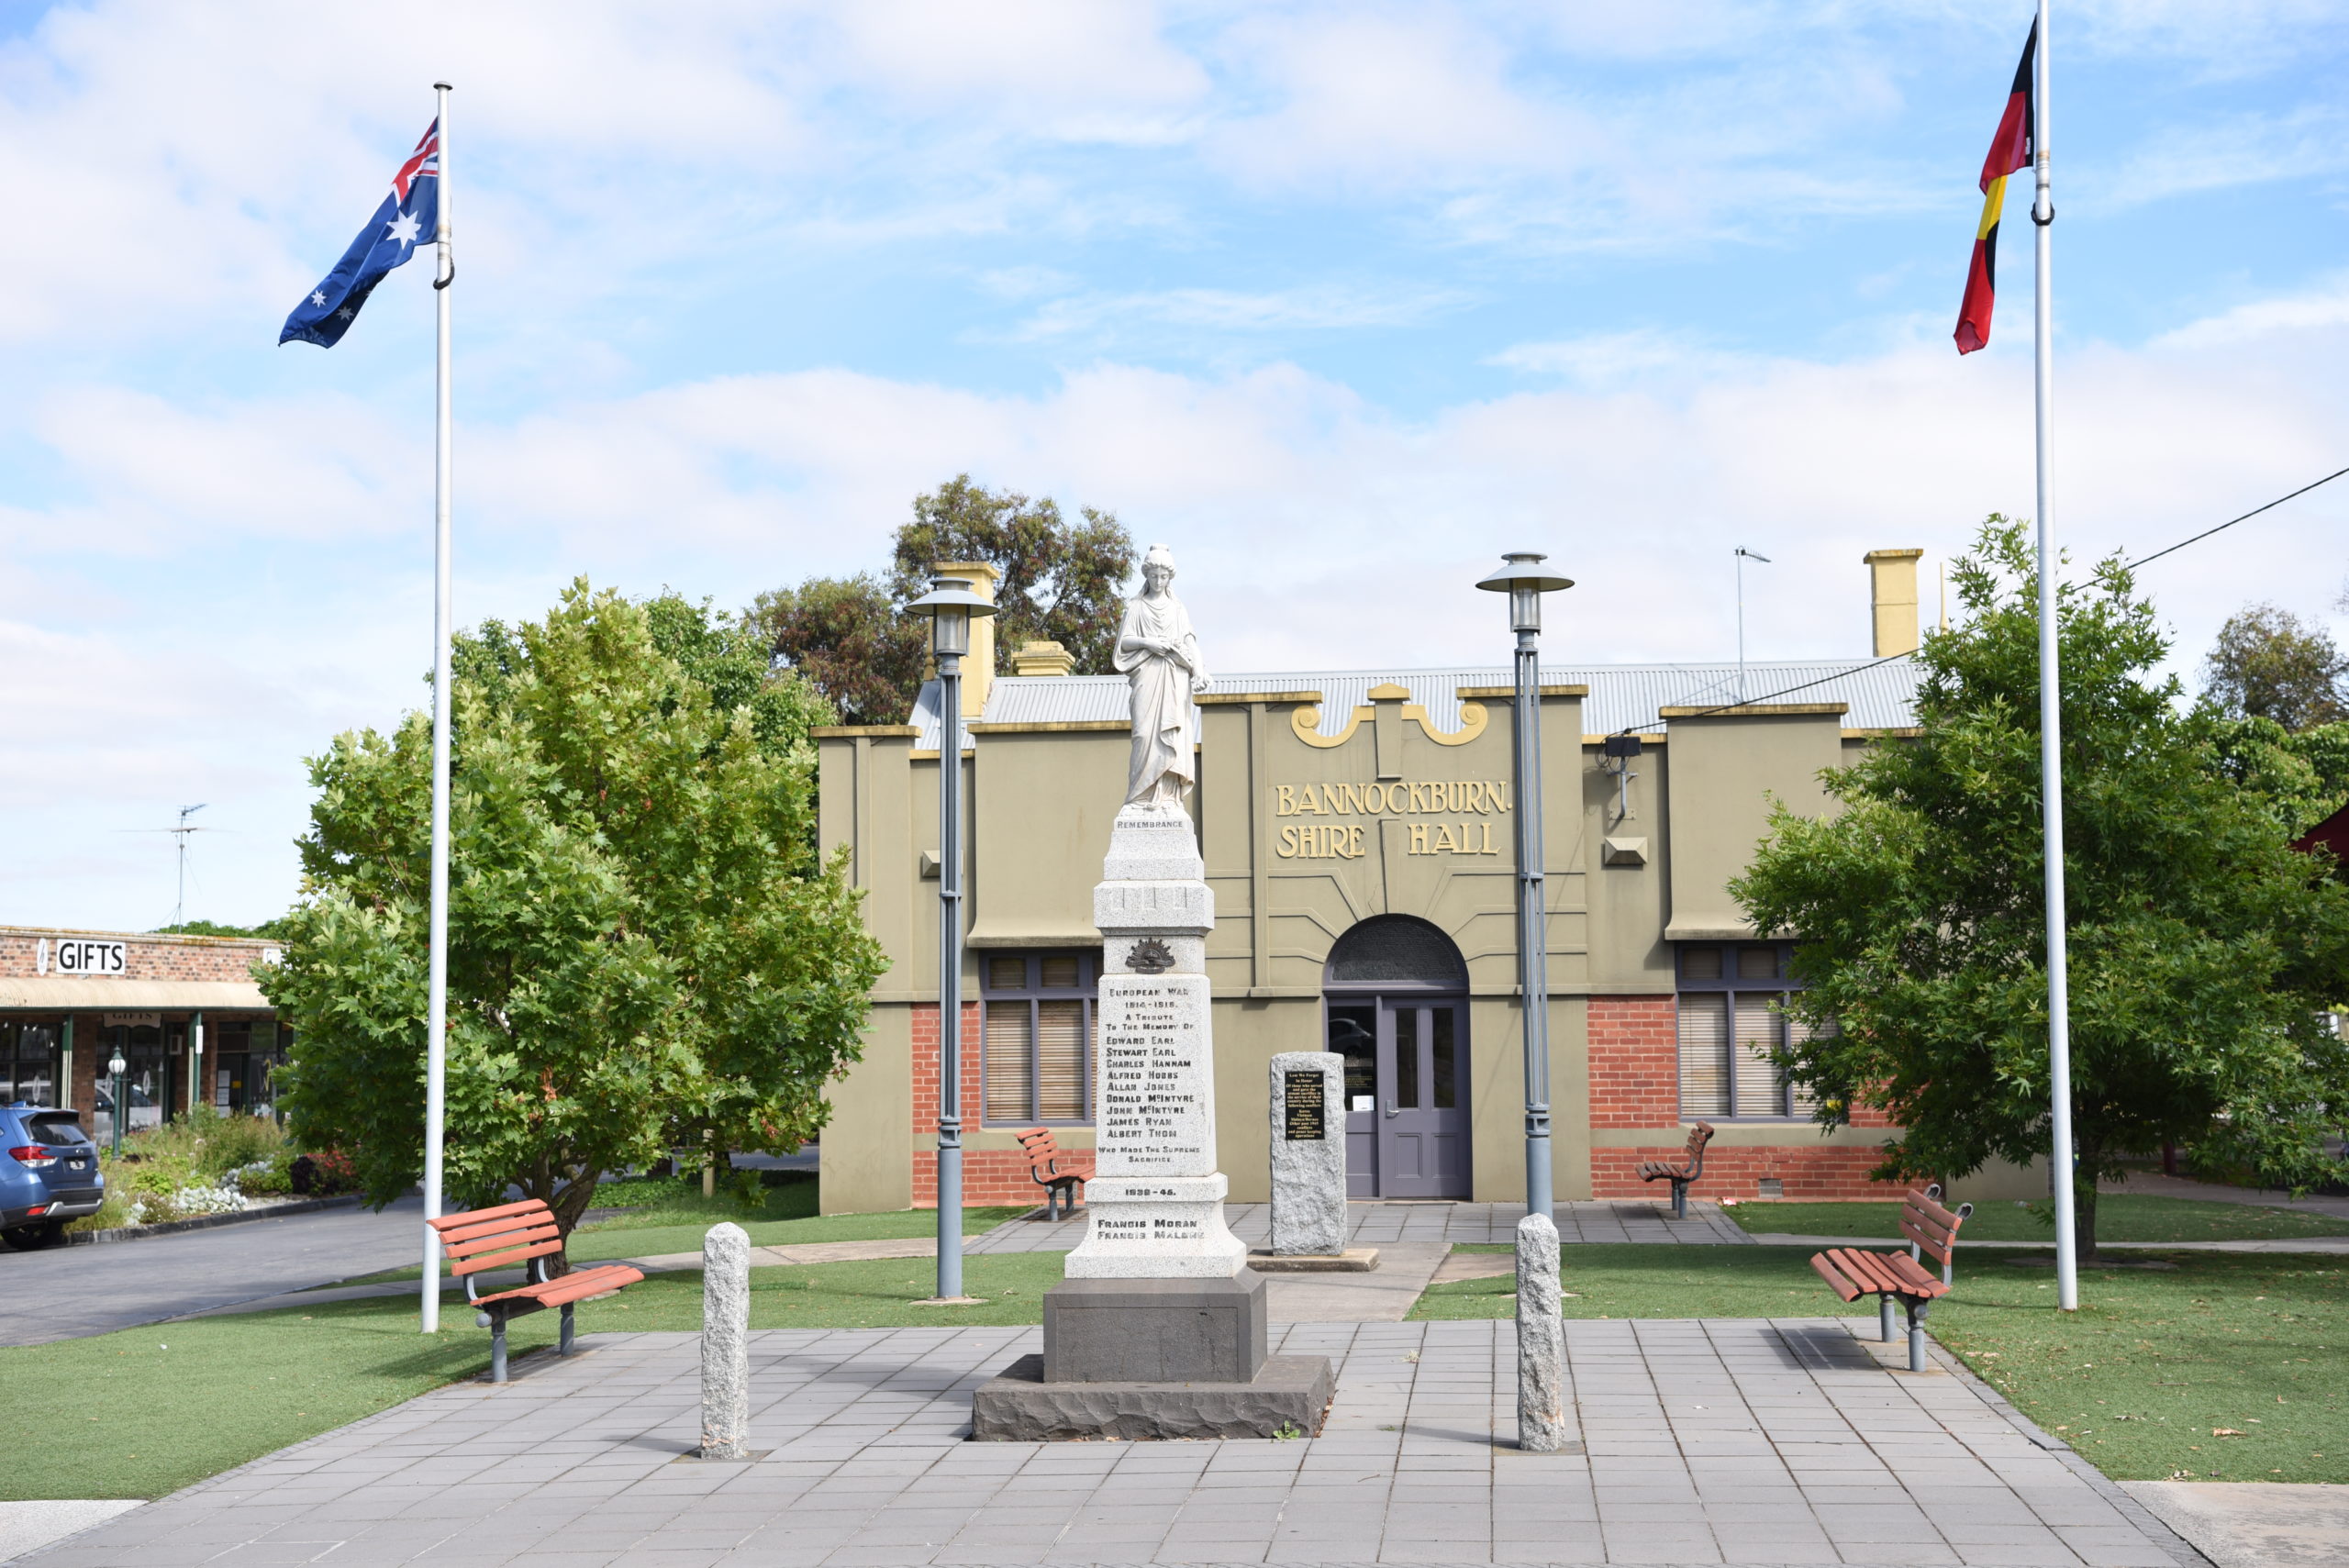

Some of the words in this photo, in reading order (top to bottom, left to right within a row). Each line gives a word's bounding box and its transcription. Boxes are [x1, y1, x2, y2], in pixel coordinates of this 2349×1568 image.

[1117, 820, 1183, 828] REMEMBRANCE
[1276, 825, 1365, 859] SHIRE
[1408, 822, 1501, 856] HALL
[59, 942, 122, 971] GIFTS
[1110, 988, 1161, 996] EUROPEAN
[1167, 987, 1188, 995] WAR
[1107, 1037, 1144, 1045] EDWARD
[1107, 1048, 1148, 1057] STEWART
[1152, 1048, 1176, 1056] EARL
[1107, 1059, 1144, 1068] CHARLES
[1149, 1071, 1178, 1079] HOBBS
[1107, 1083, 1137, 1091] ALLAN
[1144, 1083, 1175, 1091] JONES
[1107, 1095, 1141, 1103] DONALD
[1107, 1118, 1140, 1126] JAMES
[1146, 1118, 1172, 1126] RYAN
[1107, 1129, 1142, 1138] ALBERT
[1097, 1219, 1146, 1228] FRANCIS
[1154, 1219, 1197, 1228] MORAN
[1097, 1231, 1146, 1240] FRANCIS
